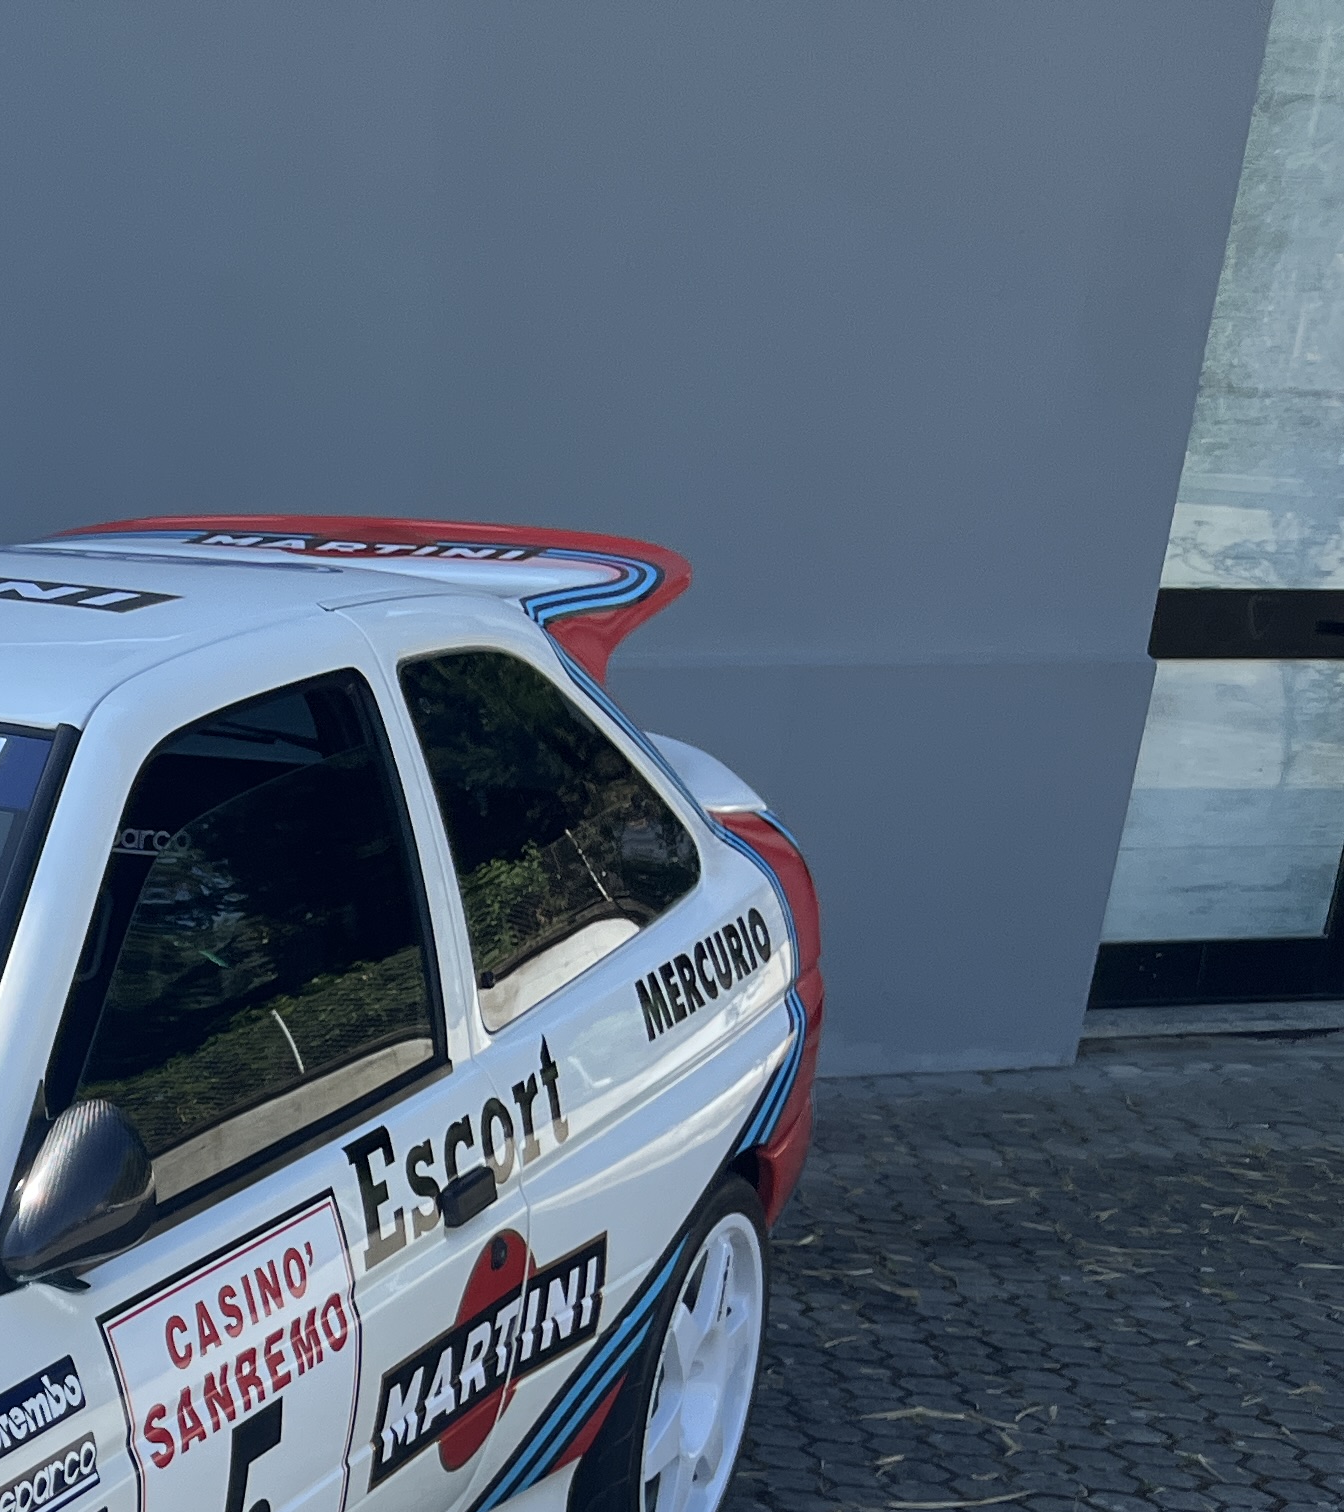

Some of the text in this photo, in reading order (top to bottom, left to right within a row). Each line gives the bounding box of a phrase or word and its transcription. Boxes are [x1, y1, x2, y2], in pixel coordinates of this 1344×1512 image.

[203, 534, 526, 560] MARTINI
[112, 828, 192, 850] arco
[635, 908, 770, 1042] MERCURIO
[343, 1034, 568, 1271] Escort
[144, 1293, 348, 1469] SANREMO
[381, 1256, 599, 1463] MARTINI
